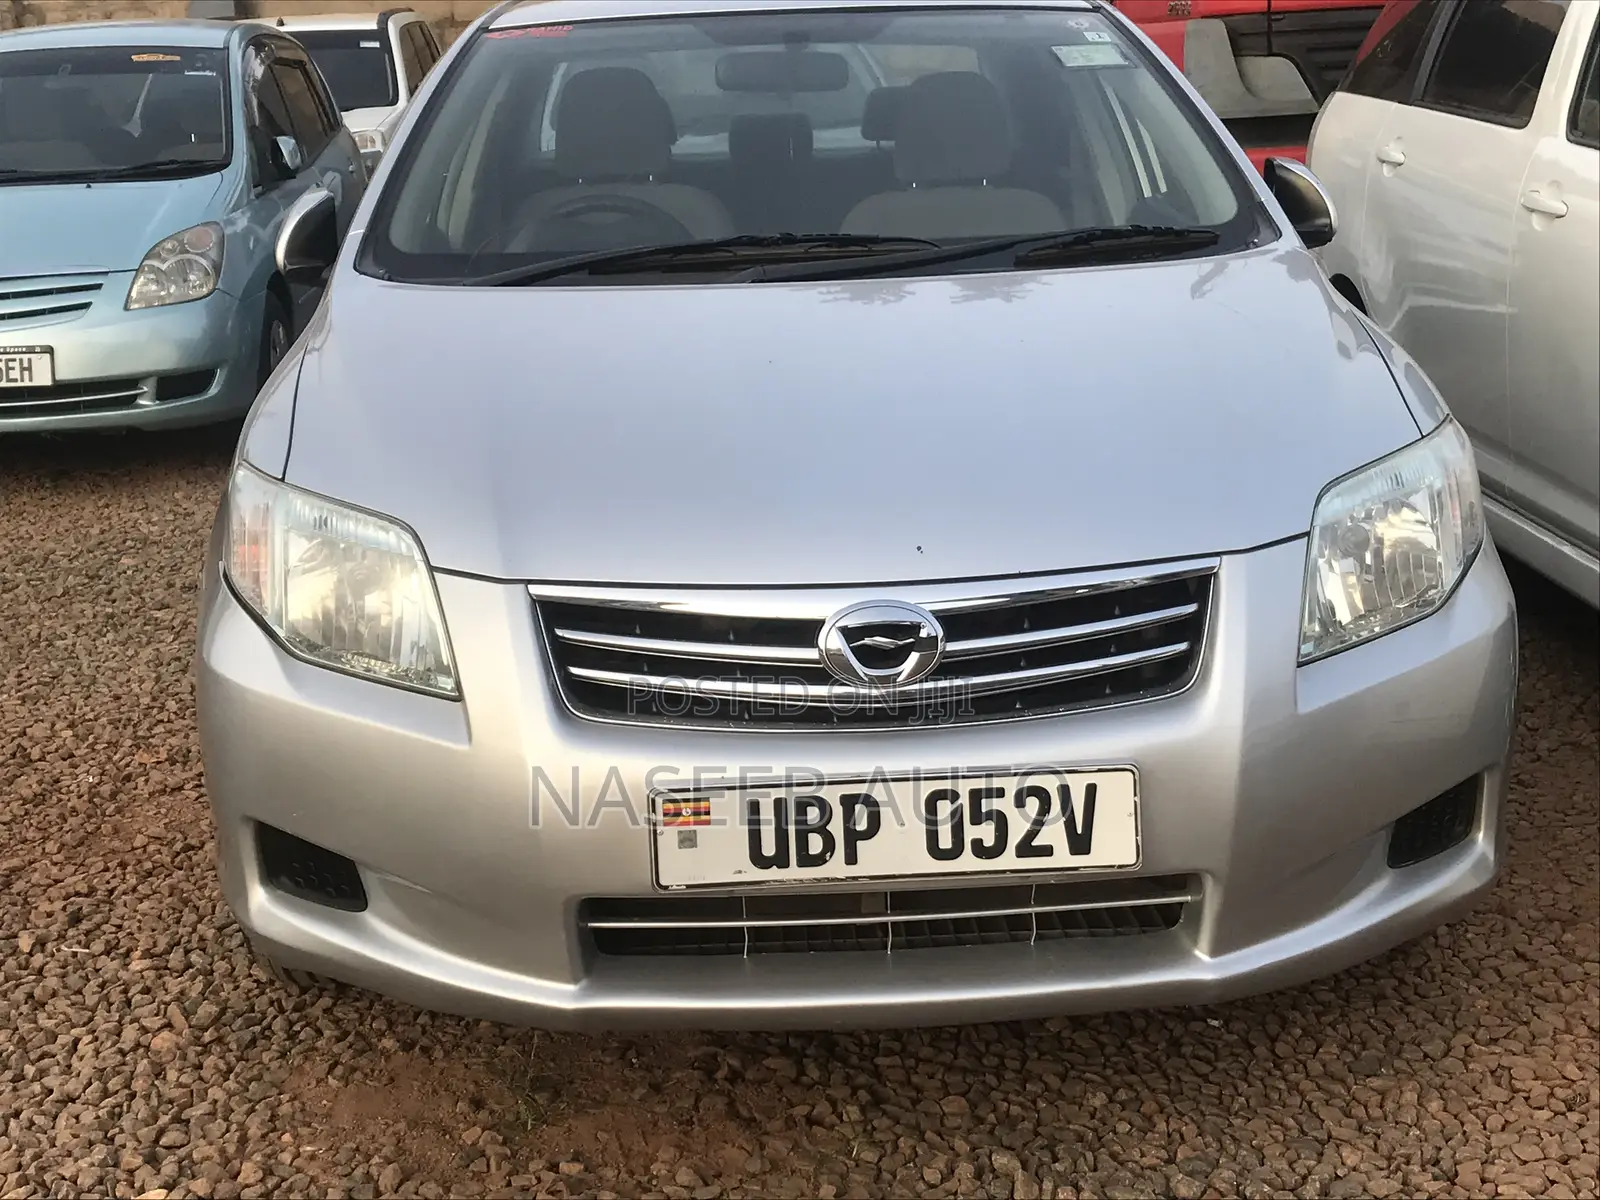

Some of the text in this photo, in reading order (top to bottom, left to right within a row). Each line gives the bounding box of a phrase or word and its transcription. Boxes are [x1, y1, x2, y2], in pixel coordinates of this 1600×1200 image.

[0, 357, 33, 383] EH
[748, 782, 1098, 869] UBP 052V
